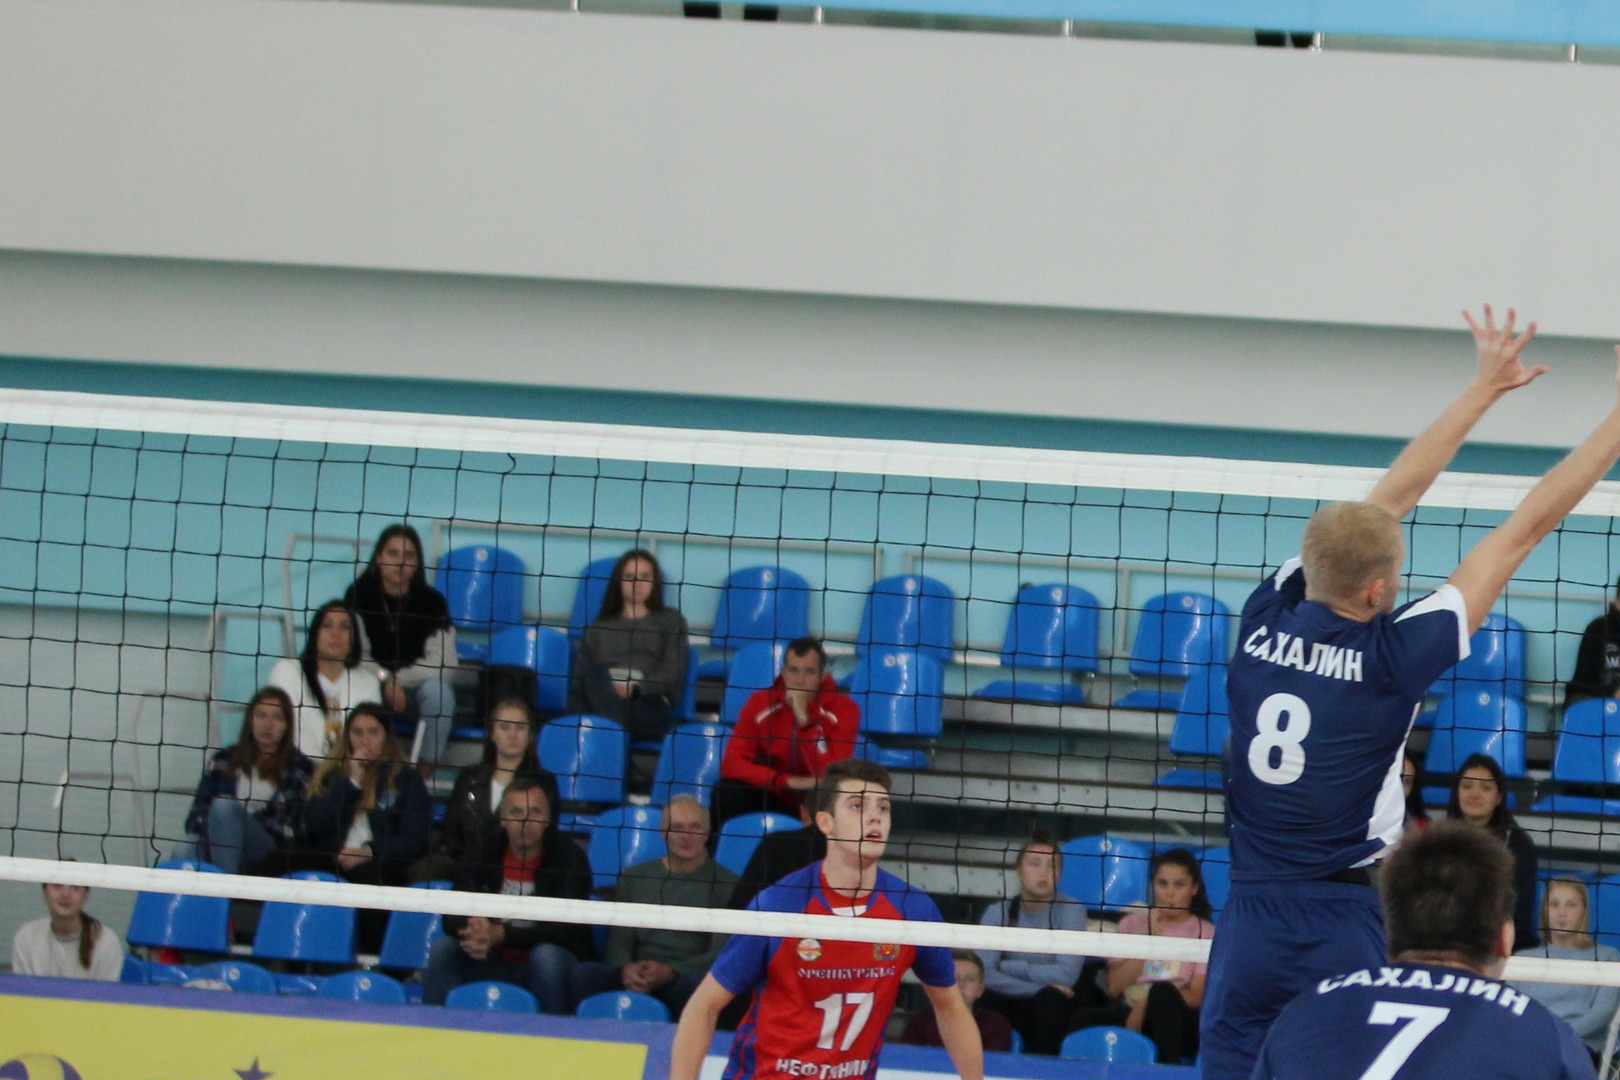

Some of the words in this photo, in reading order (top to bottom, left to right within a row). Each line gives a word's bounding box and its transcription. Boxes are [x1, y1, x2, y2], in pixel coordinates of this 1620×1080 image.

[1244, 625, 1363, 682] САХАЛИН
[1248, 692, 1311, 786] 8
[1316, 967, 1531, 1016] САХАЛИН
[814, 992, 874, 1051] 17
